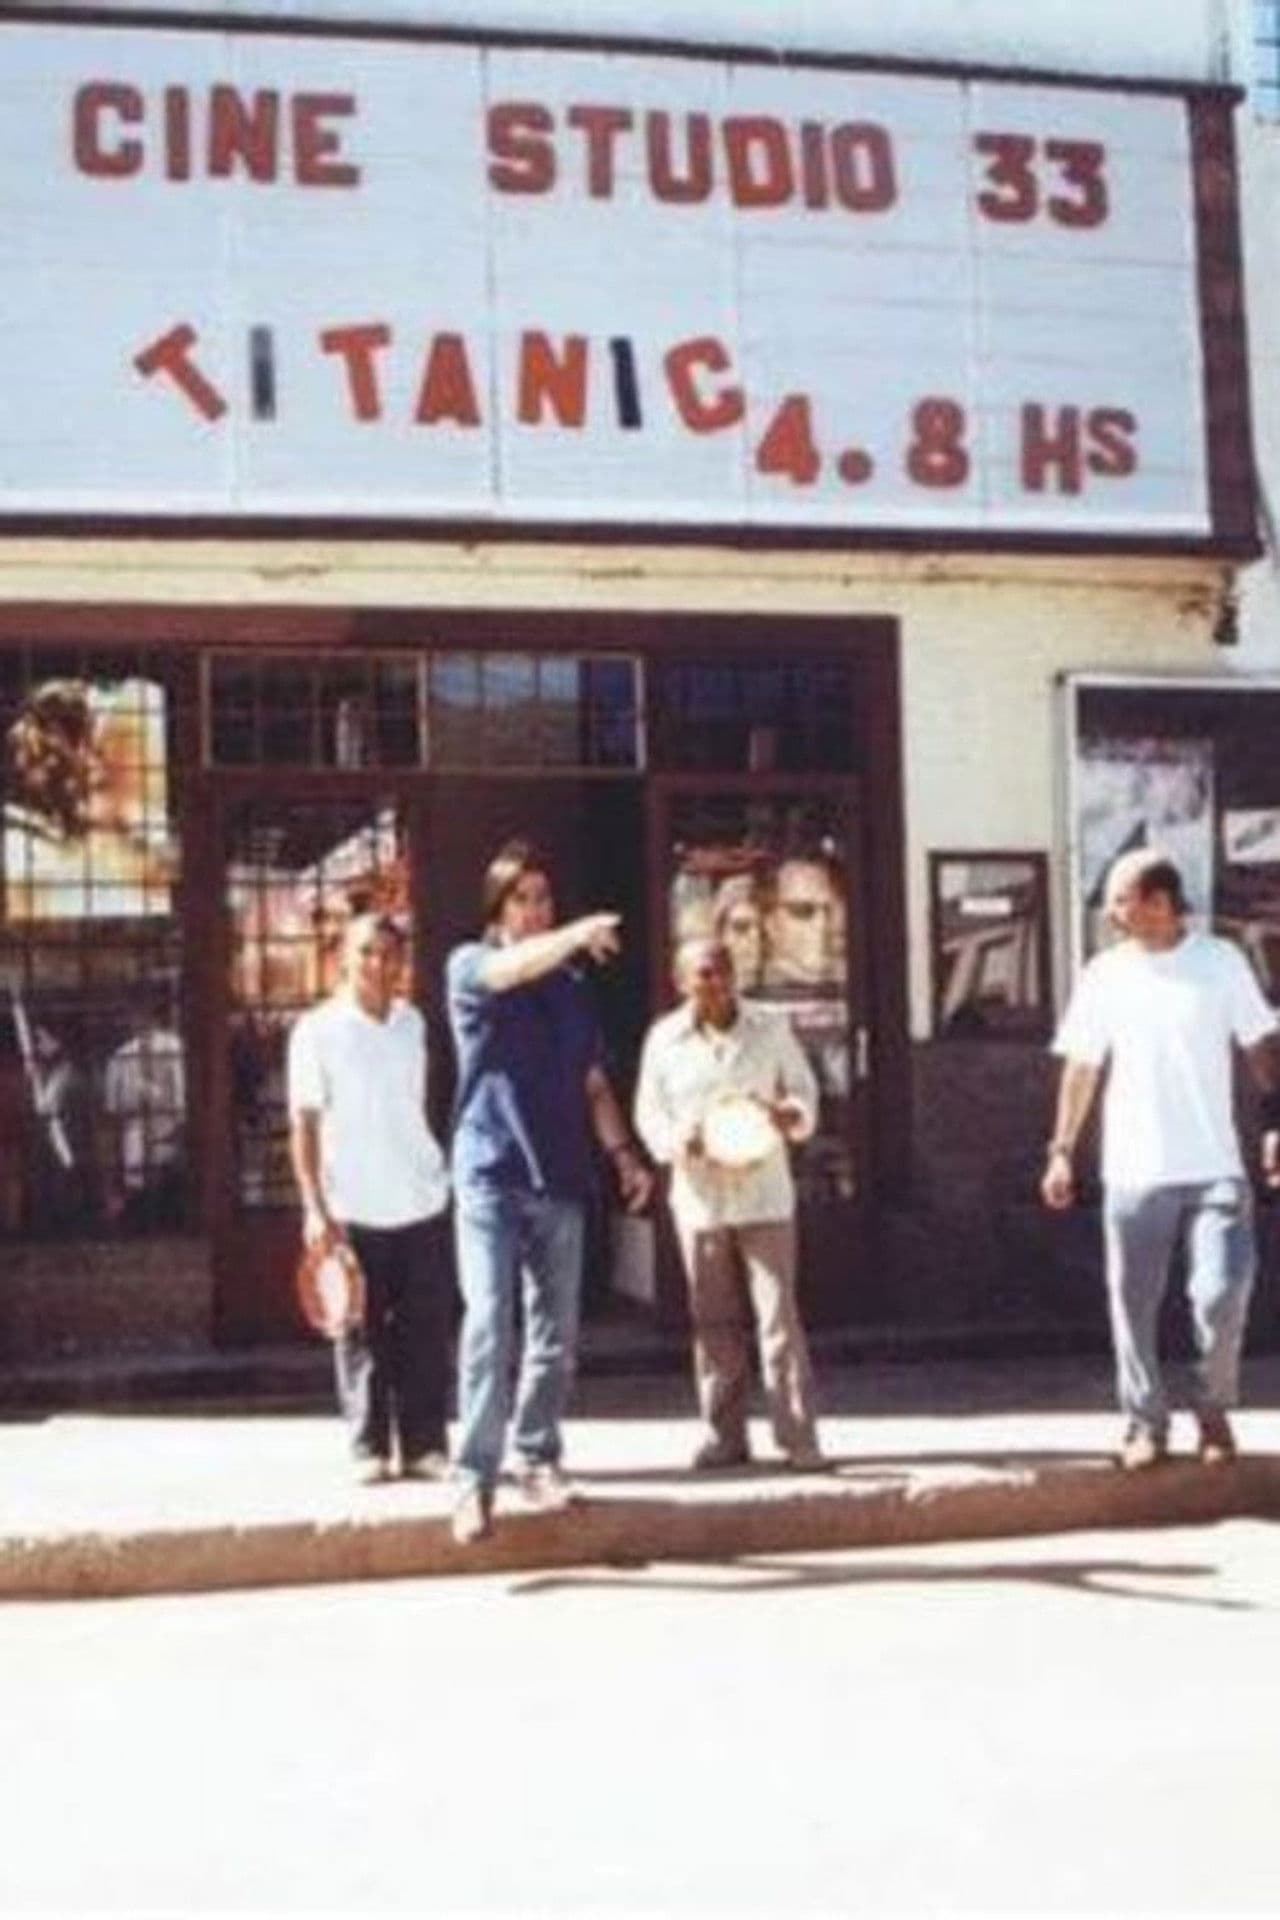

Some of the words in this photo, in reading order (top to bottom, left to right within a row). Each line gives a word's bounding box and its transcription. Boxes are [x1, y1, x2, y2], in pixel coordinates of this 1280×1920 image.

[73, 82, 361, 188] CINE
[486, 103, 898, 213] STUDIO
[973, 132, 1110, 229] 33
[133, 324, 746, 434] TITANIC
[1020, 402, 1138, 496] HS
